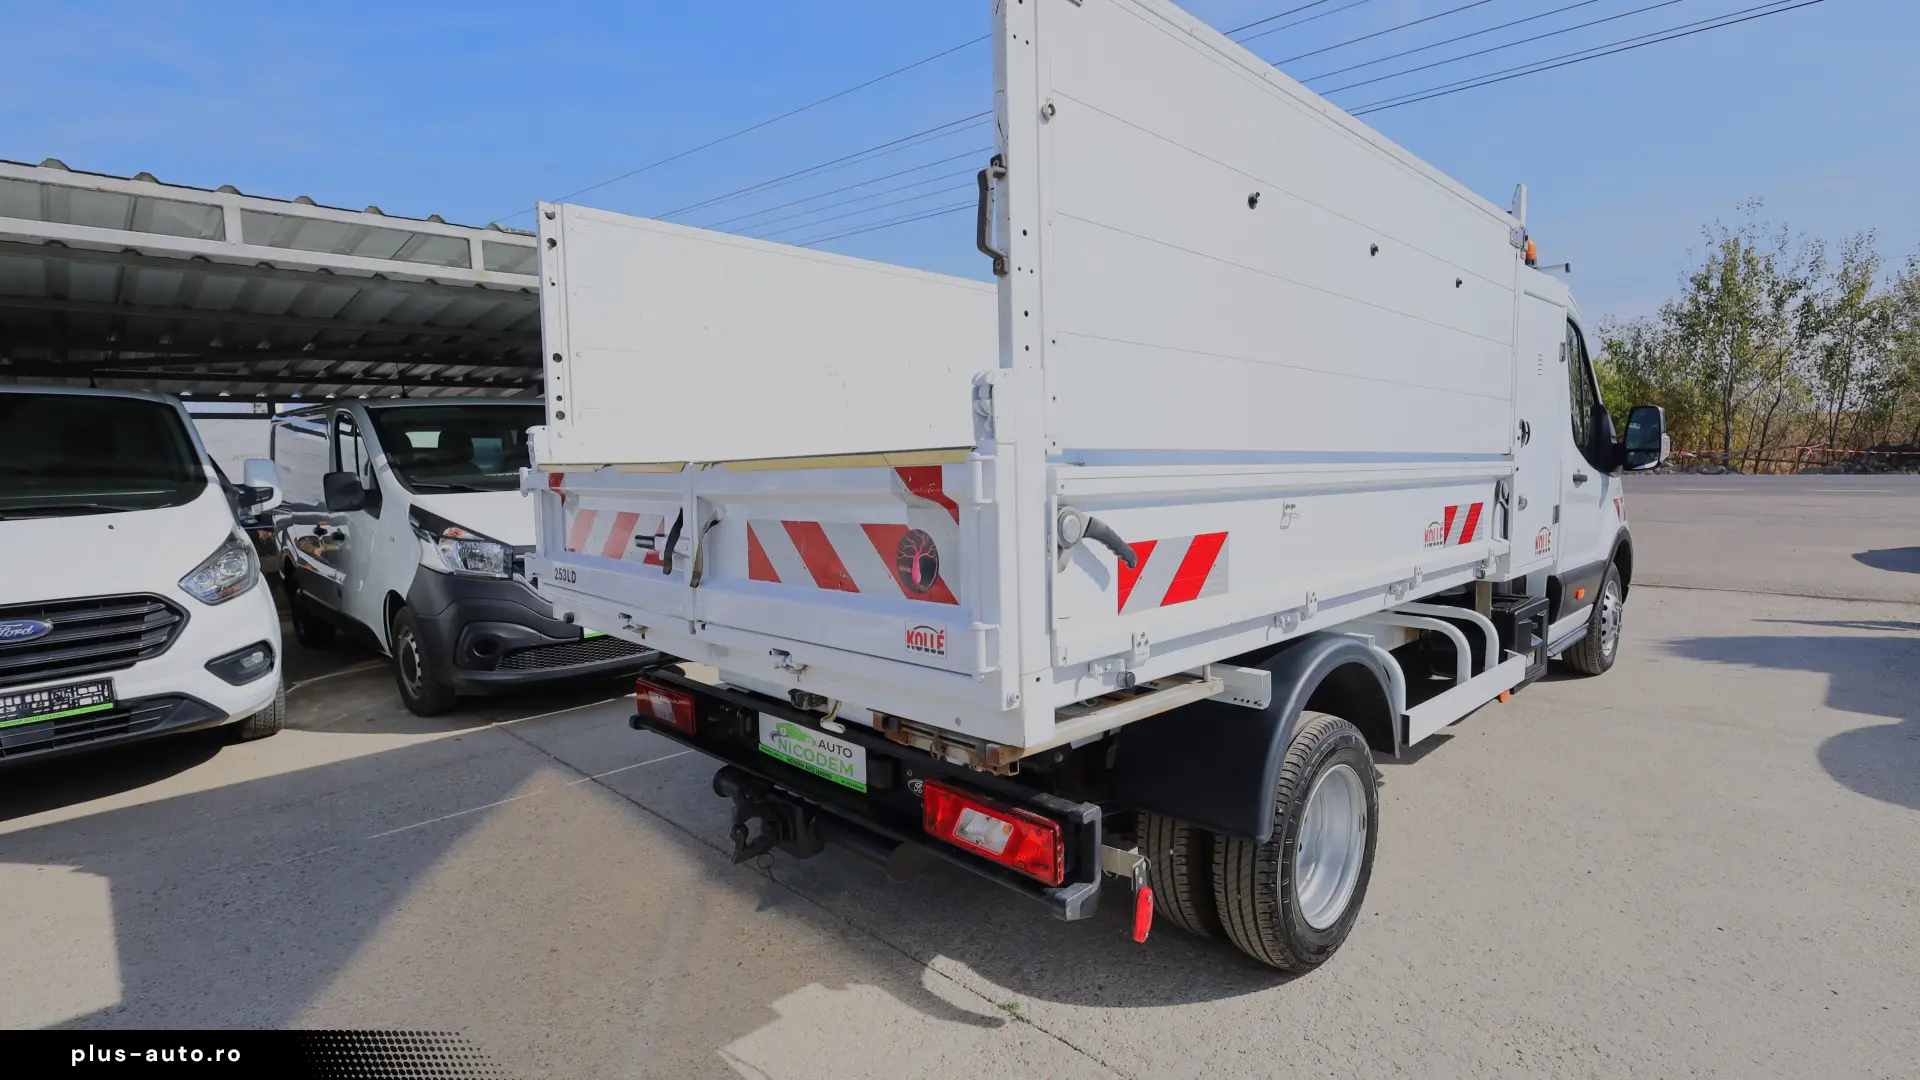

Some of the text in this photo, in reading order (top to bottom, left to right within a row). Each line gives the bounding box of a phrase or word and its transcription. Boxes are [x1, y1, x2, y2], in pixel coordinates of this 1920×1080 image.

[554, 567, 577, 584] 253LD
[0, 623, 33, 637] Ford
[778, 737, 854, 778] NICODEM
[818, 739, 853, 759] AUTO
